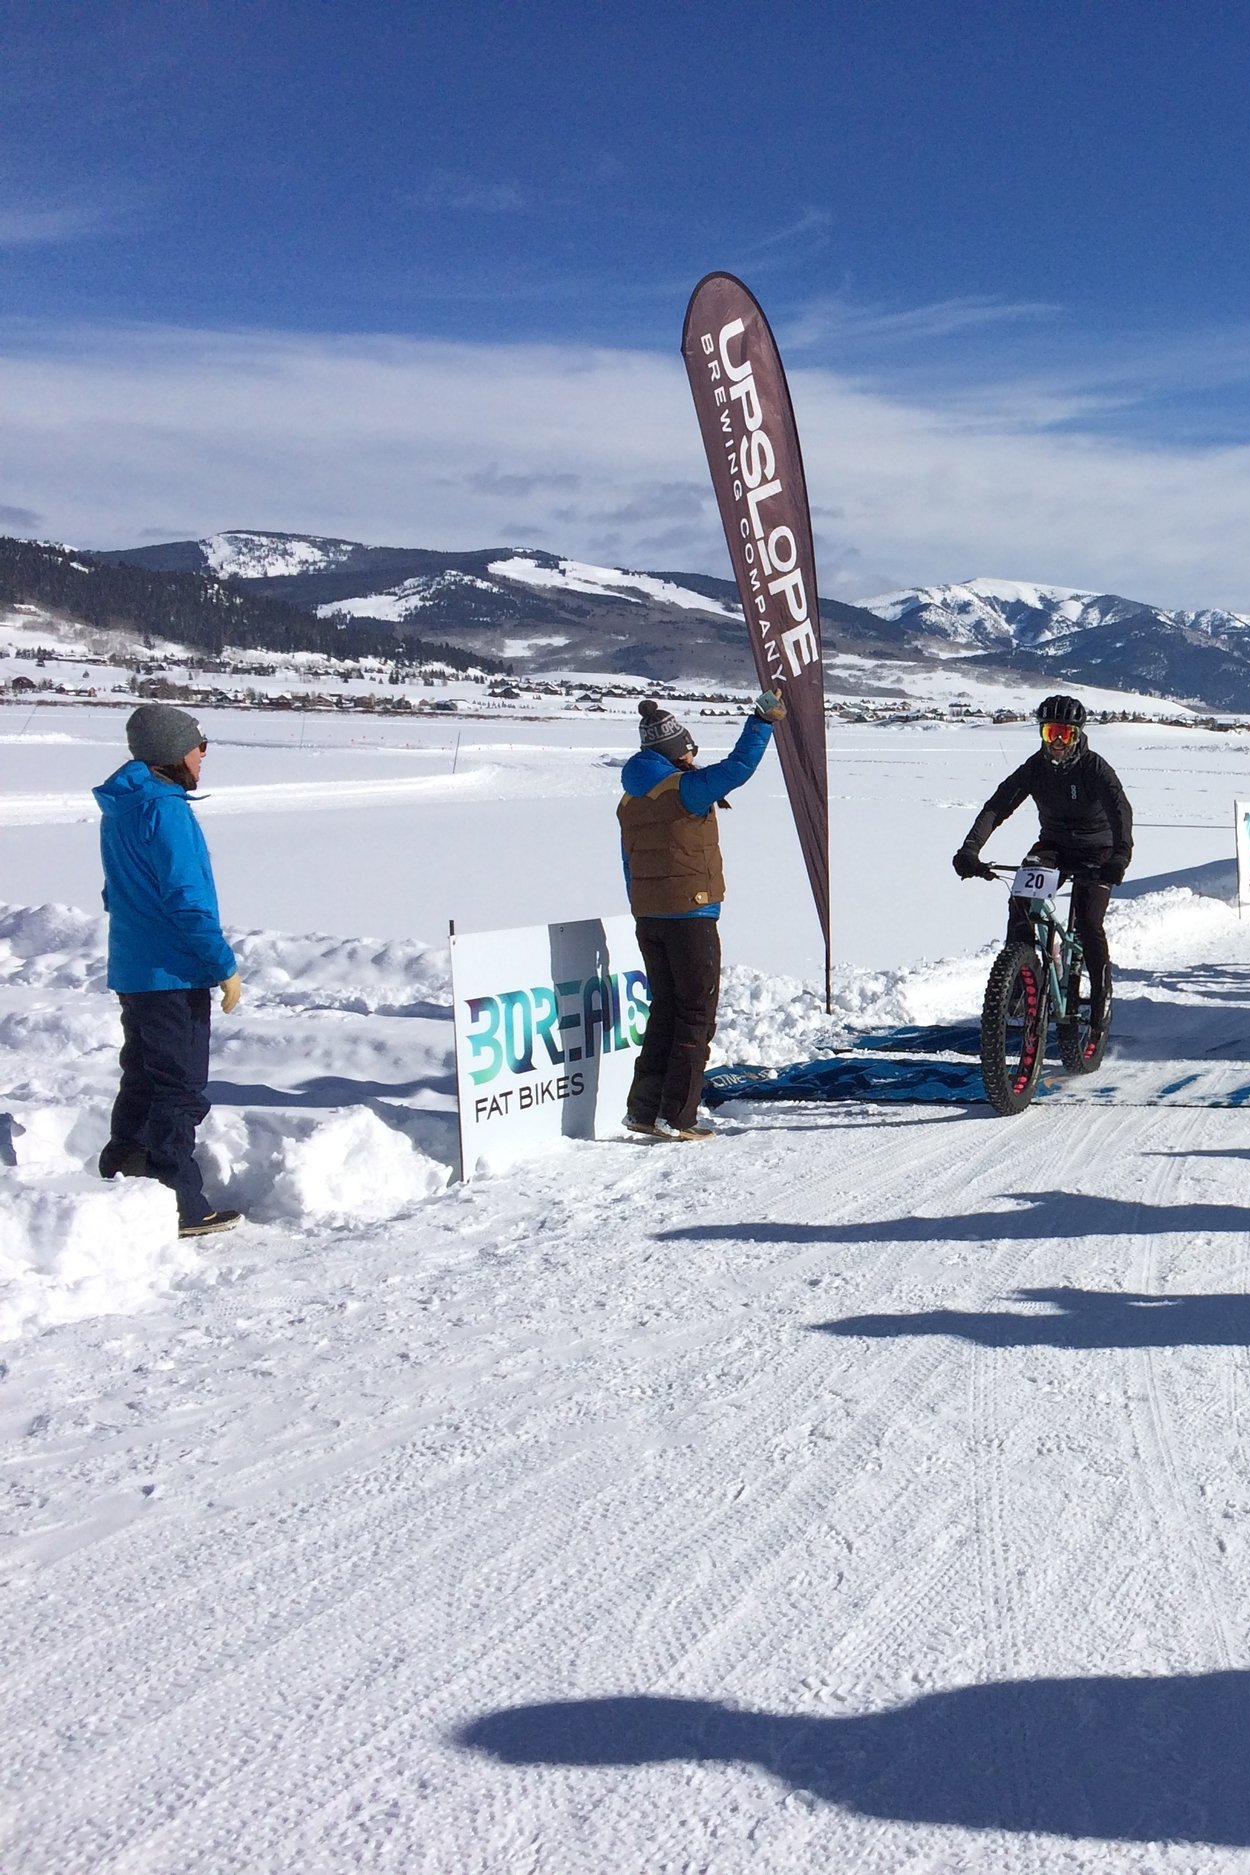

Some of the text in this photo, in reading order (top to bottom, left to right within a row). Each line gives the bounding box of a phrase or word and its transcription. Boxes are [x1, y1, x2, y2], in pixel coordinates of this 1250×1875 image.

[700, 332, 788, 683] BREWING COMPANY
[719, 317, 820, 678] UPSLOPE
[640, 716, 681, 743] PSLOPE
[1024, 872, 1045, 890] 20
[475, 1072, 585, 1124] FAT BIKES
